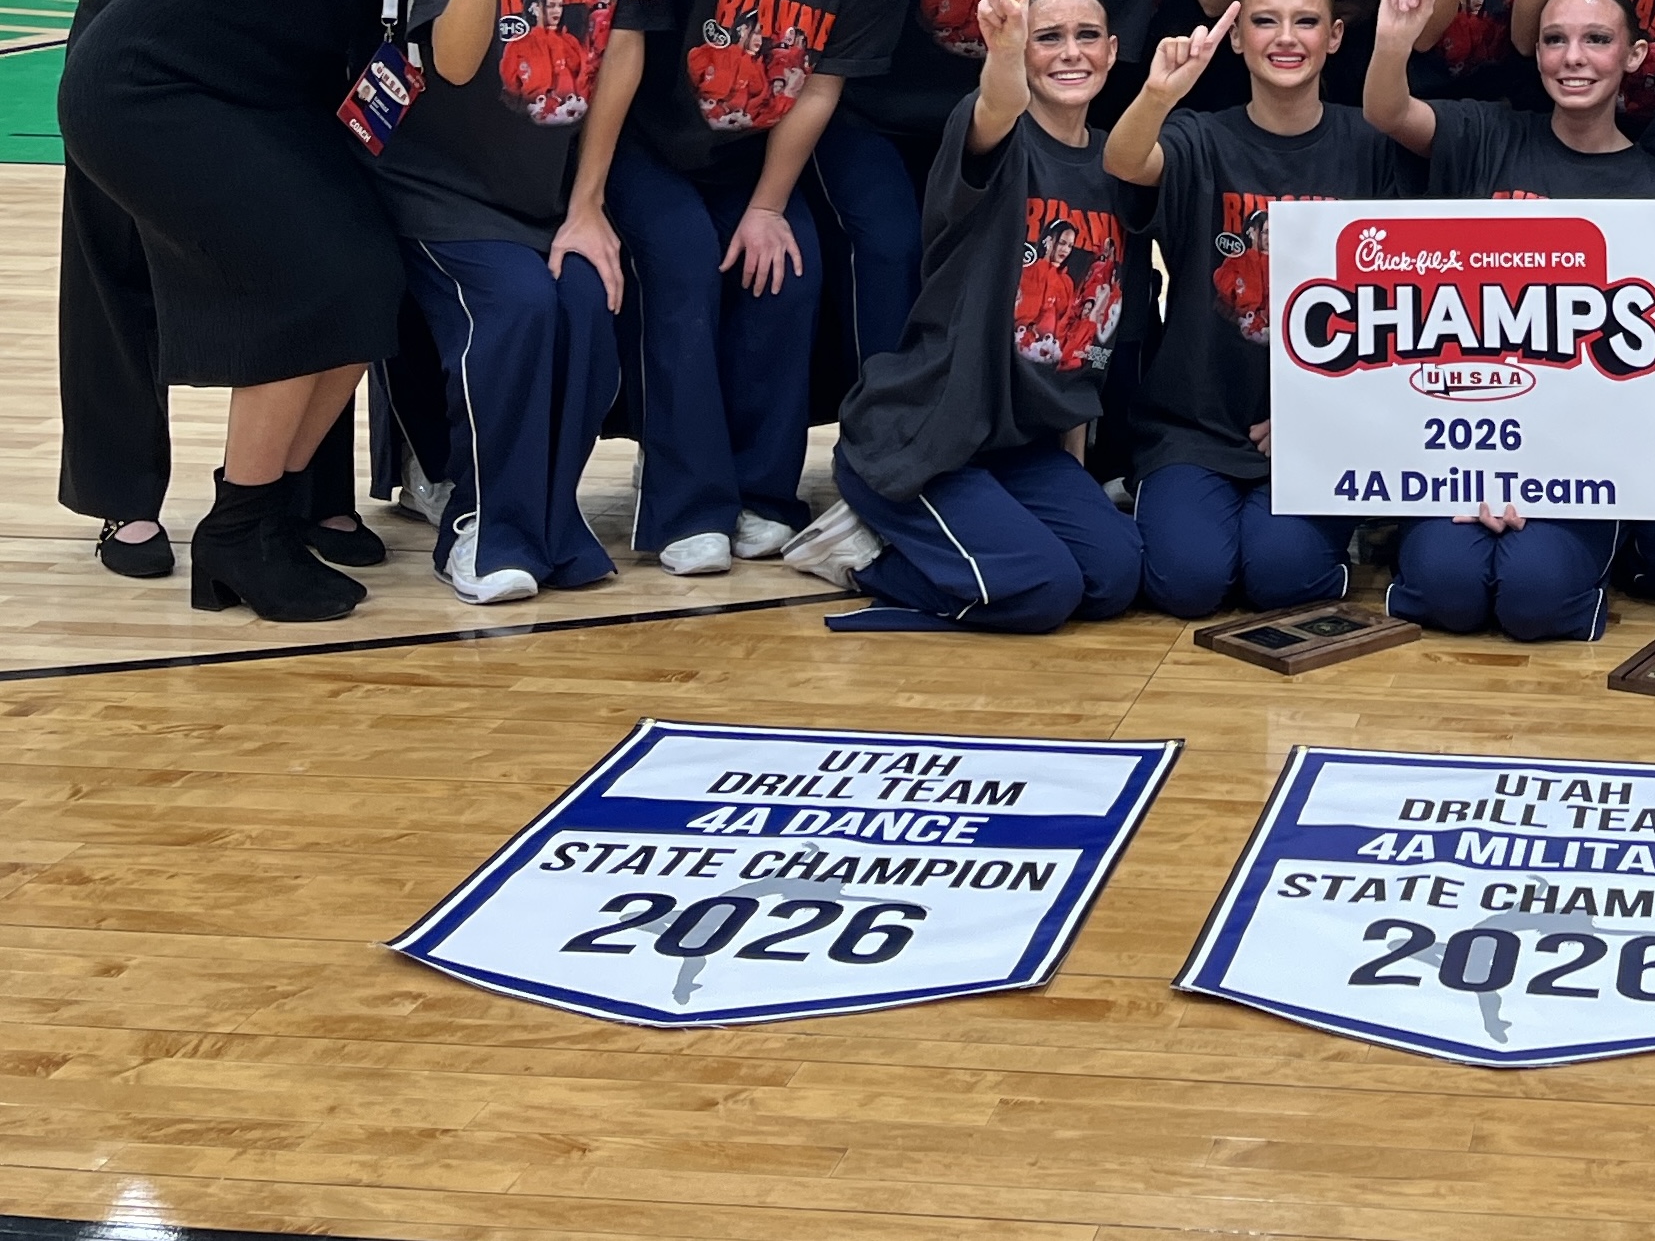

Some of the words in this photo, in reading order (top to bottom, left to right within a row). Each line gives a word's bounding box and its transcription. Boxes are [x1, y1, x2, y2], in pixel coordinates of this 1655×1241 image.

[349, 118, 371, 143] COACH
[1219, 236, 1242, 252] RHS
[1355, 230, 1464, 273] Chick-fil-A
[1470, 252, 1546, 268] CHICKEN
[1551, 251, 1586, 268] FOR
[1427, 370, 1523, 386] UHSAA
[1424, 418, 1522, 451] 2026
[1334, 469, 1391, 502] 4A
[1402, 467, 1484, 503] Drill
[1495, 472, 1616, 505] Team
[819, 750, 961, 778] UTAH
[707, 771, 877, 801] DRILL
[880, 776, 1027, 807] TEAM
[1494, 774, 1633, 805] UTAH
[686, 805, 764, 836] 4A
[783, 809, 989, 845] DANCE
[1400, 798, 1548, 828] DRILL
[1357, 832, 1436, 861] 4A
[538, 841, 736, 880] STATE
[738, 850, 1056, 892] CHAMPION
[1276, 873, 1465, 909] STATE
[559, 892, 930, 965] 2026
